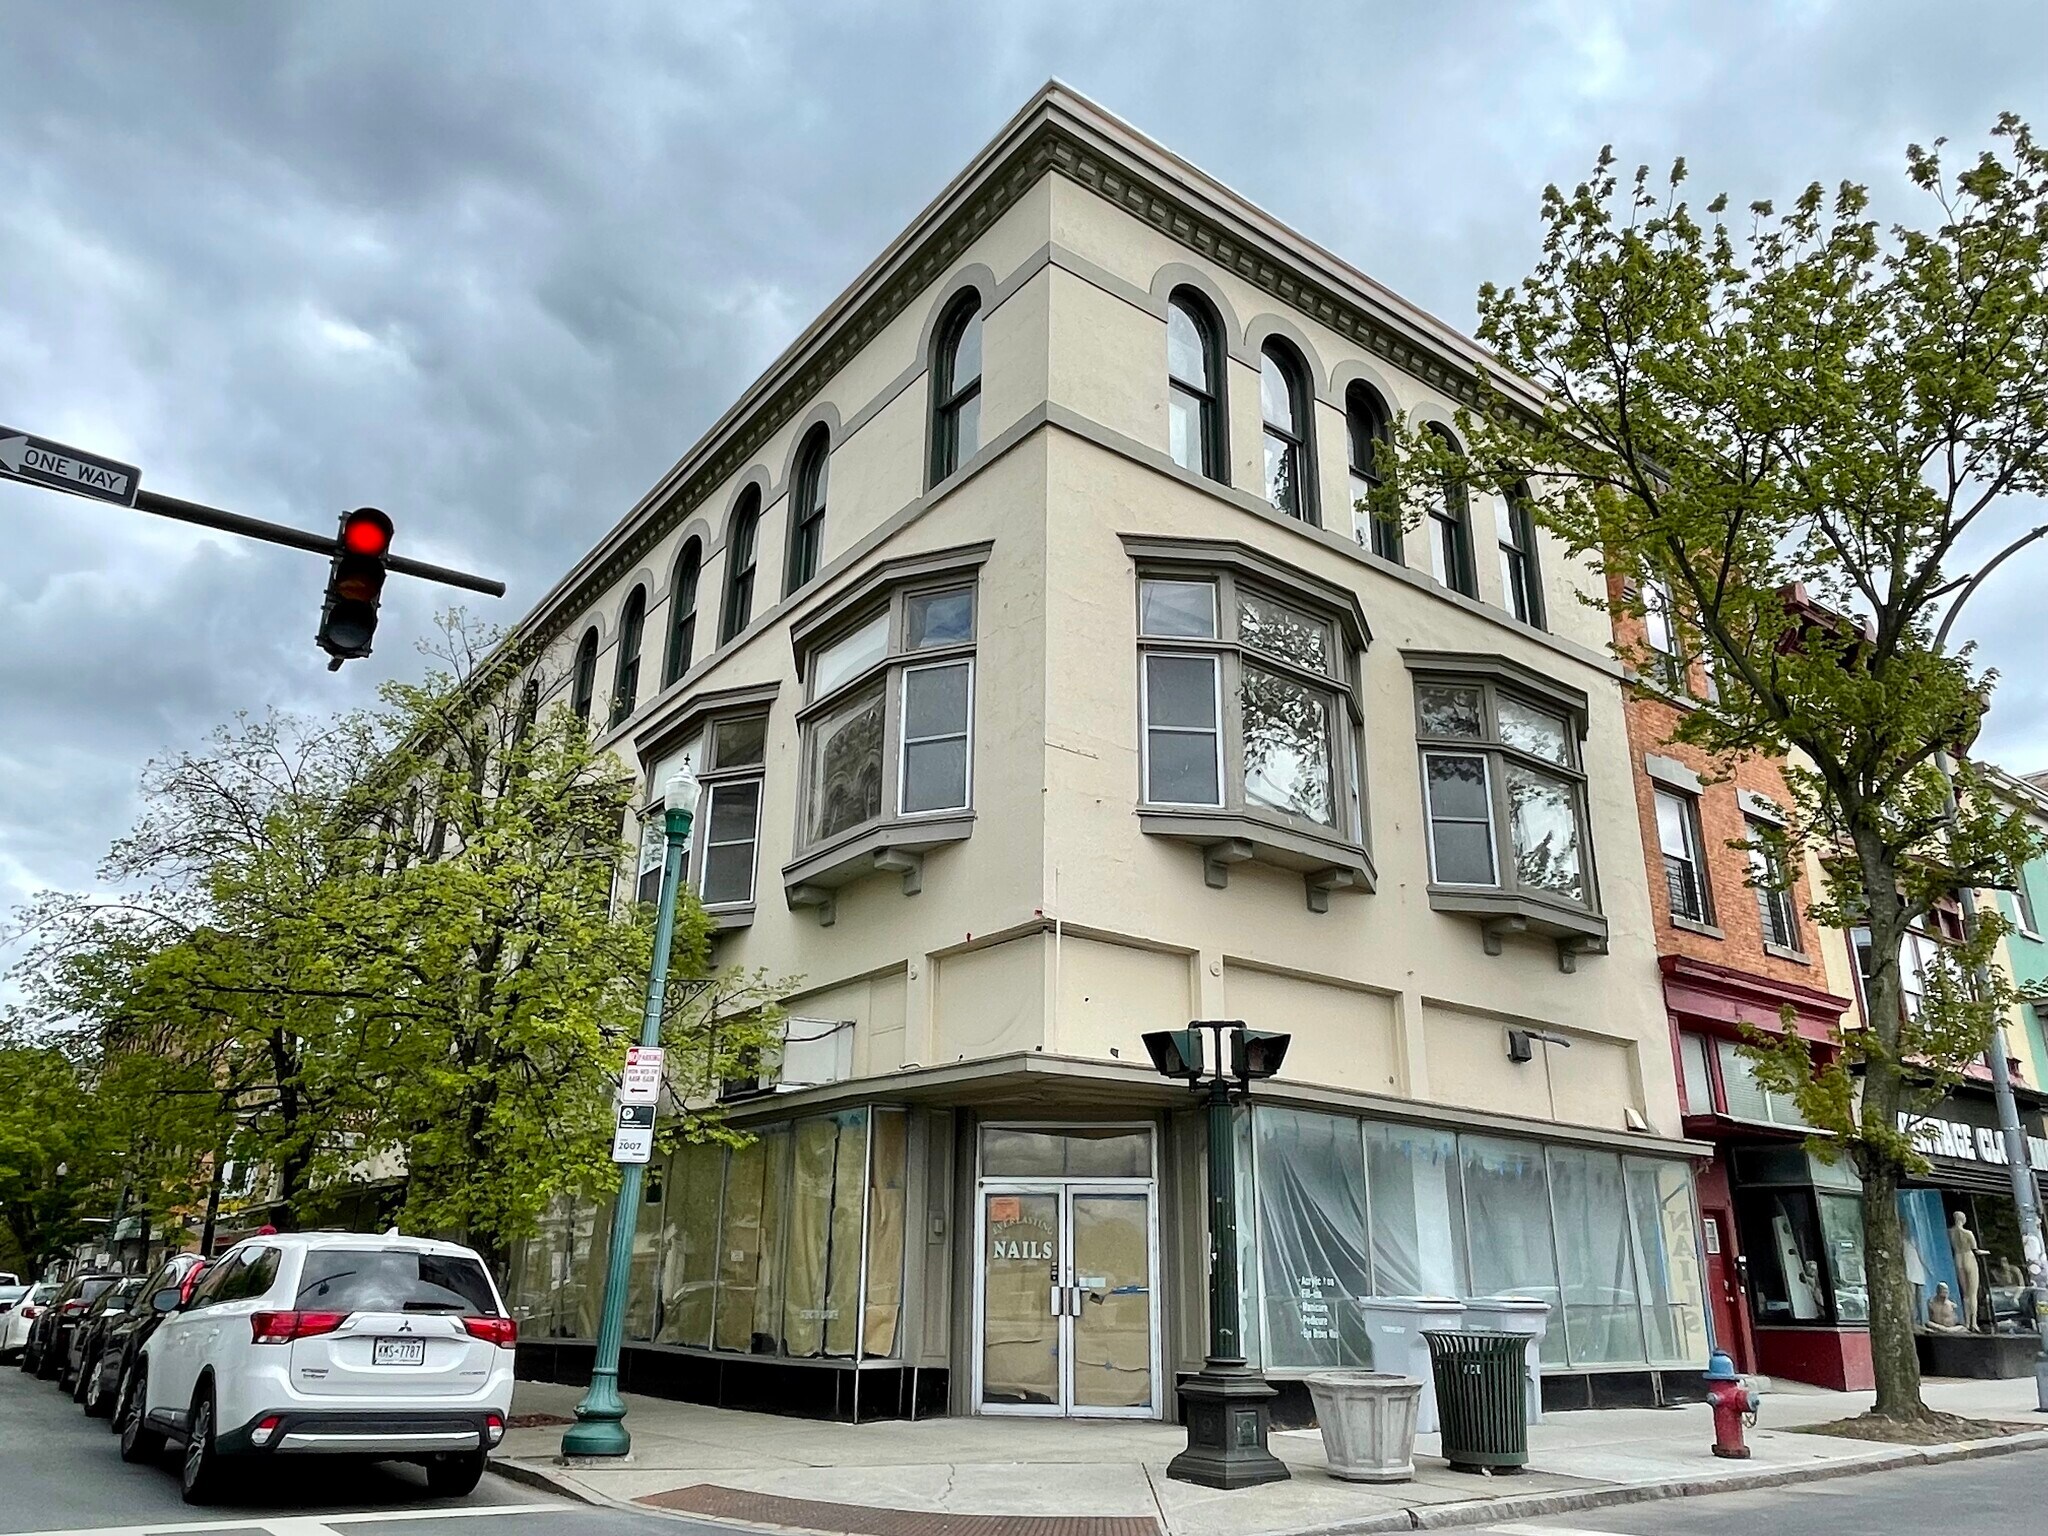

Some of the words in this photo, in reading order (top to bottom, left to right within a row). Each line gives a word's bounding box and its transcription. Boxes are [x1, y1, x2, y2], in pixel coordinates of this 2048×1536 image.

[25, 449, 69, 475] ONE
[78, 464, 120, 489] WAY
[618, 1142, 642, 1150] 2007
[992, 1215, 1054, 1236] EVERLASTING
[993, 1240, 1053, 1260] NAILS
[1302, 1302, 1328, 1312] Manicure
[1302, 1315, 1328, 1326] Pedicure
